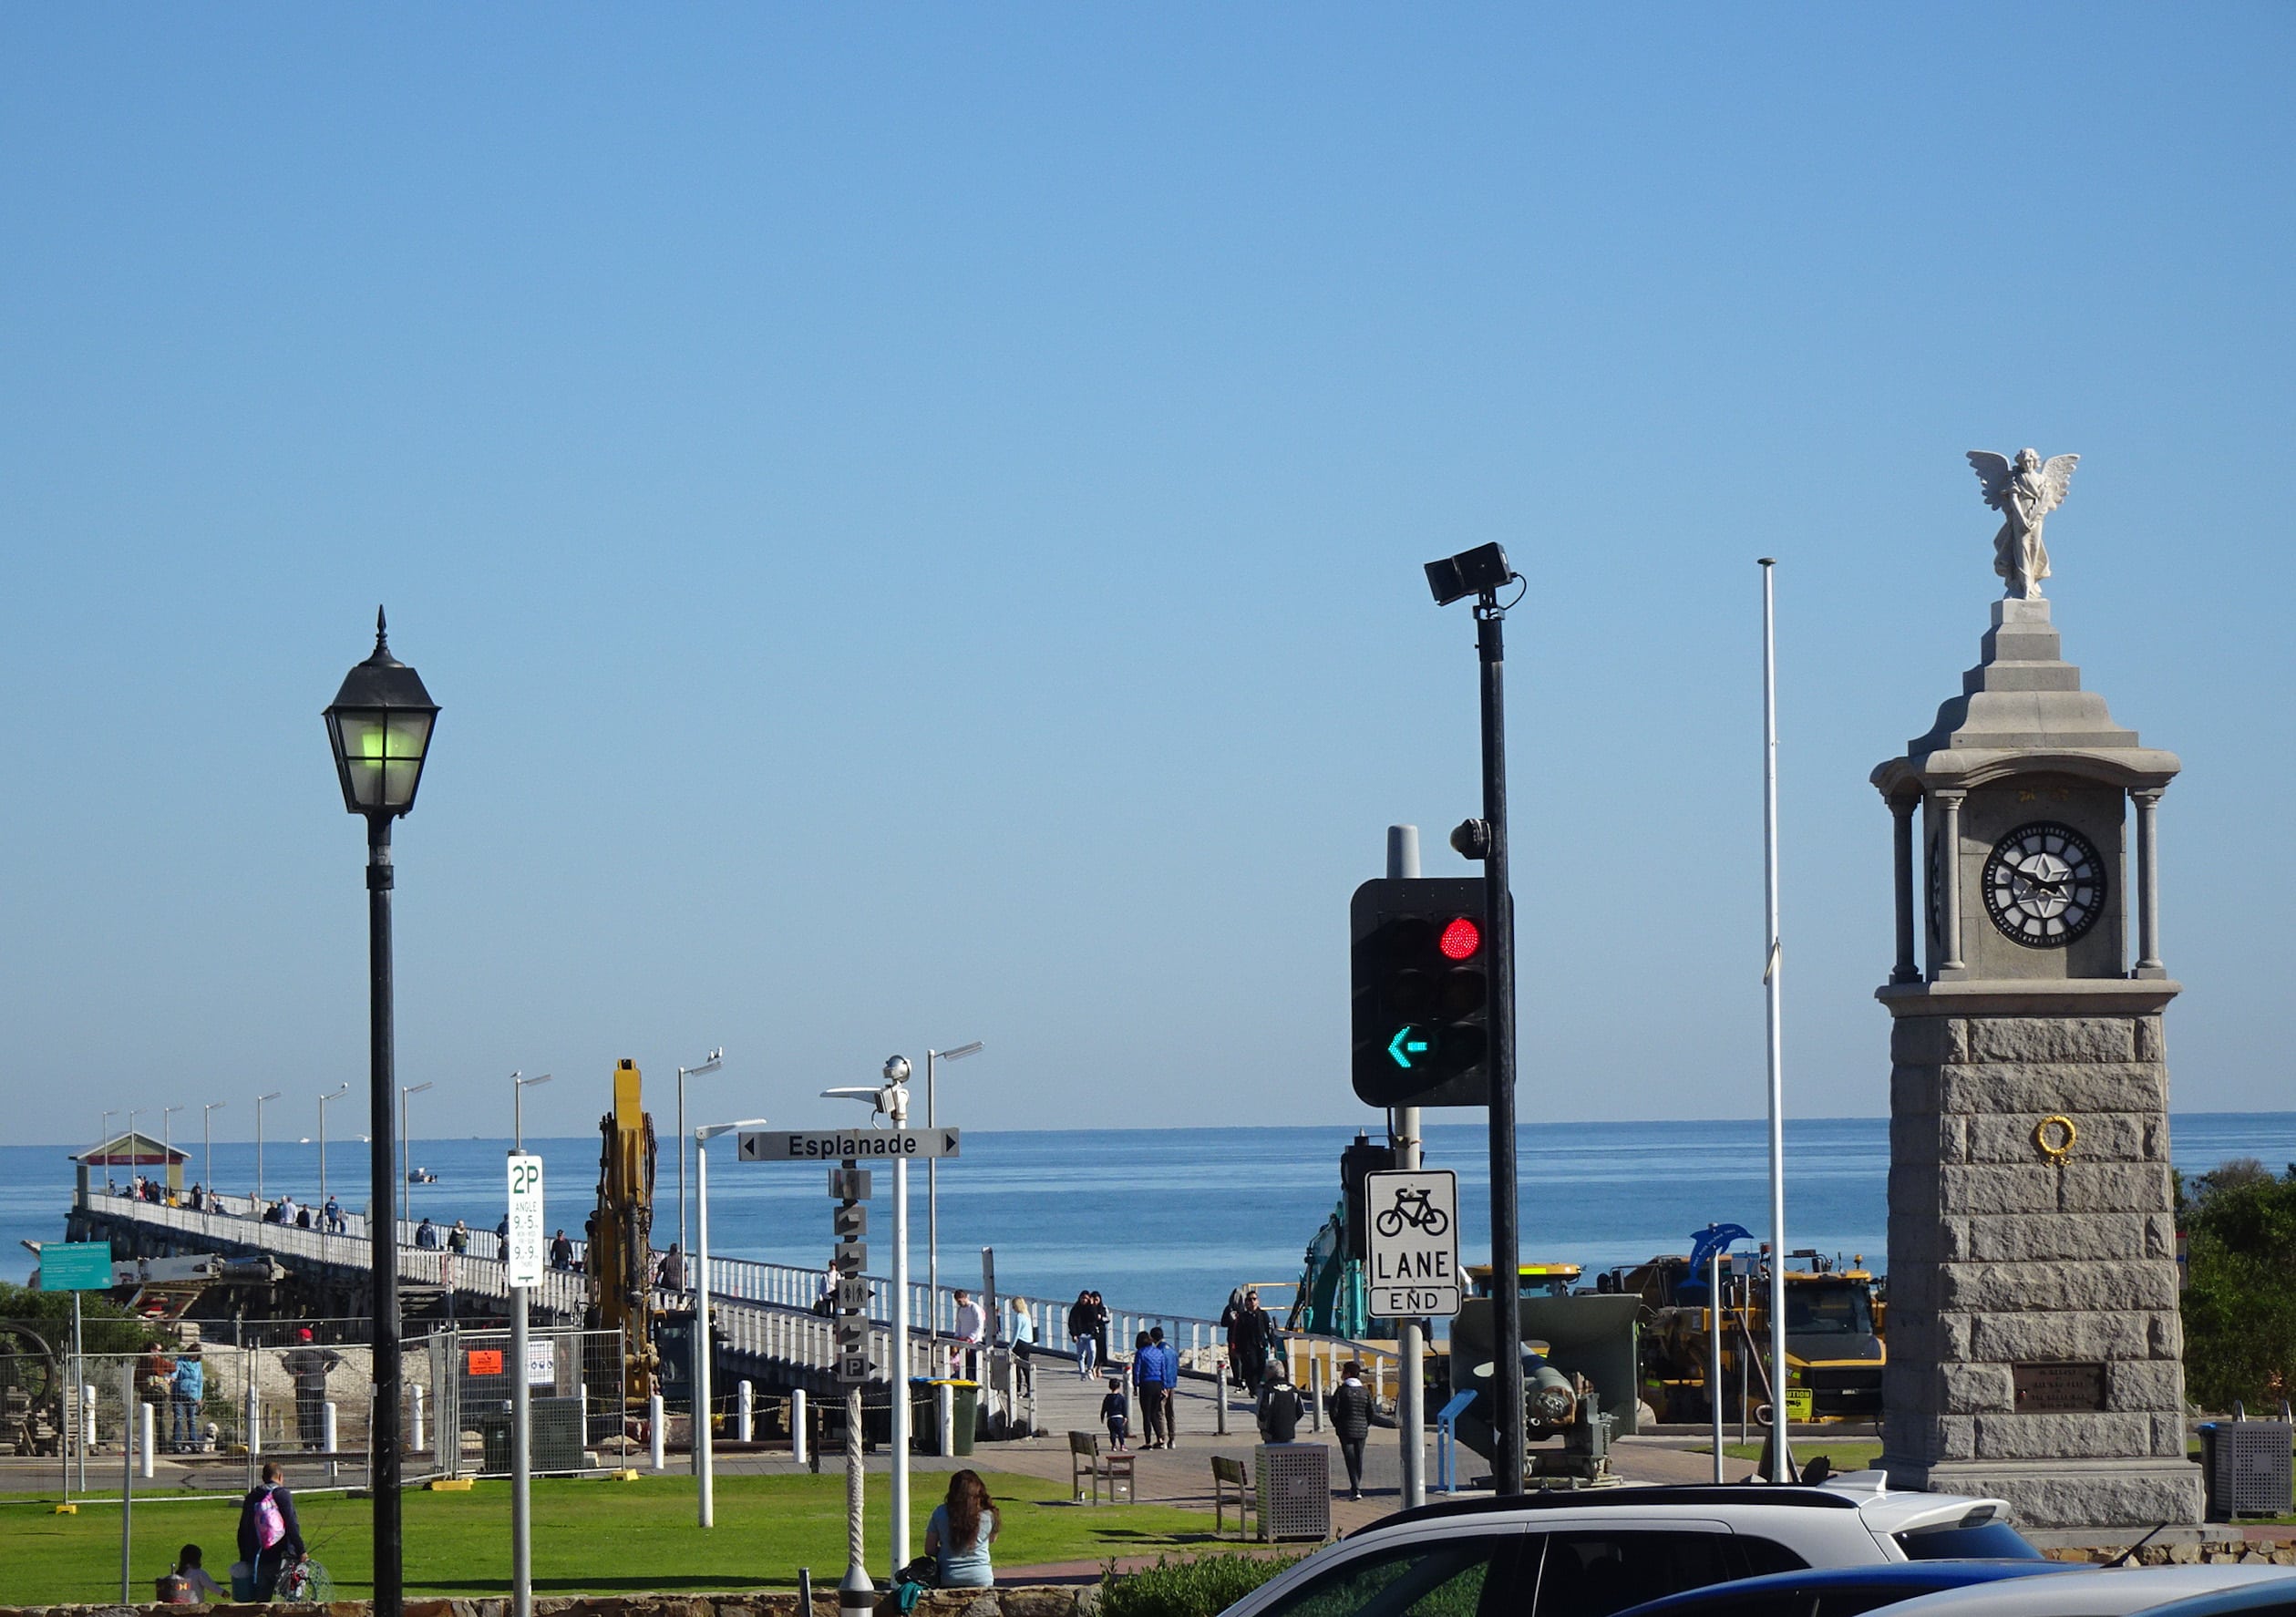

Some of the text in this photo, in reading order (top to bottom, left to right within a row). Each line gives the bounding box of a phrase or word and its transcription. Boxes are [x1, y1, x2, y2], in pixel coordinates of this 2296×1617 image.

[789, 1134, 916, 1159] Esplanade
[513, 1165, 539, 1194] 2P
[515, 1201, 537, 1212] ANGLE
[1377, 1251, 1449, 1279] LANE
[1390, 1293, 1437, 1310] END
[849, 1360, 860, 1375] P
